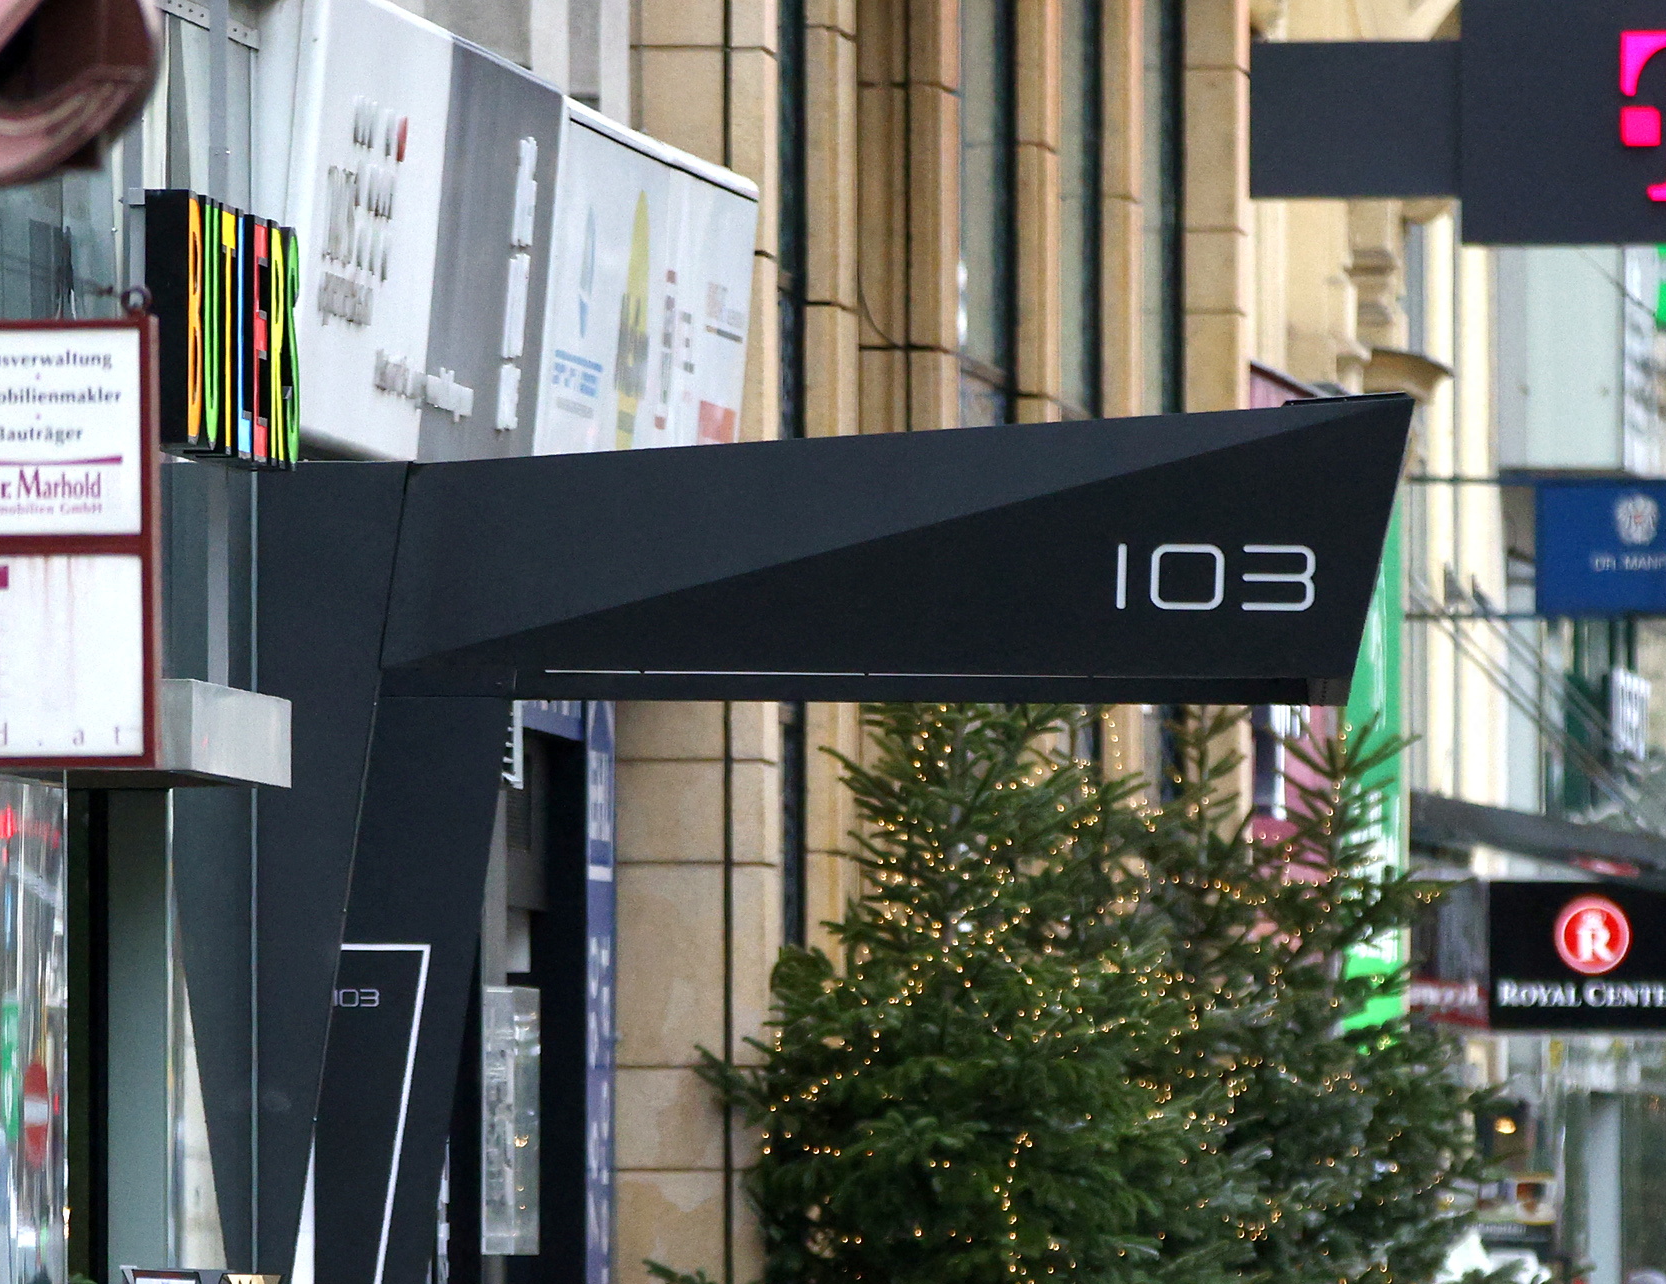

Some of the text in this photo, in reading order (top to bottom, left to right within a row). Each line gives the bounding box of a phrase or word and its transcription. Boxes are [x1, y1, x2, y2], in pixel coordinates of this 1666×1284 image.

[187, 192, 300, 470] BUTLERS
[18, 467, 101, 499] Marhold
[1117, 543, 1315, 611] 103
[1497, 978, 1582, 1008] ROYAL
